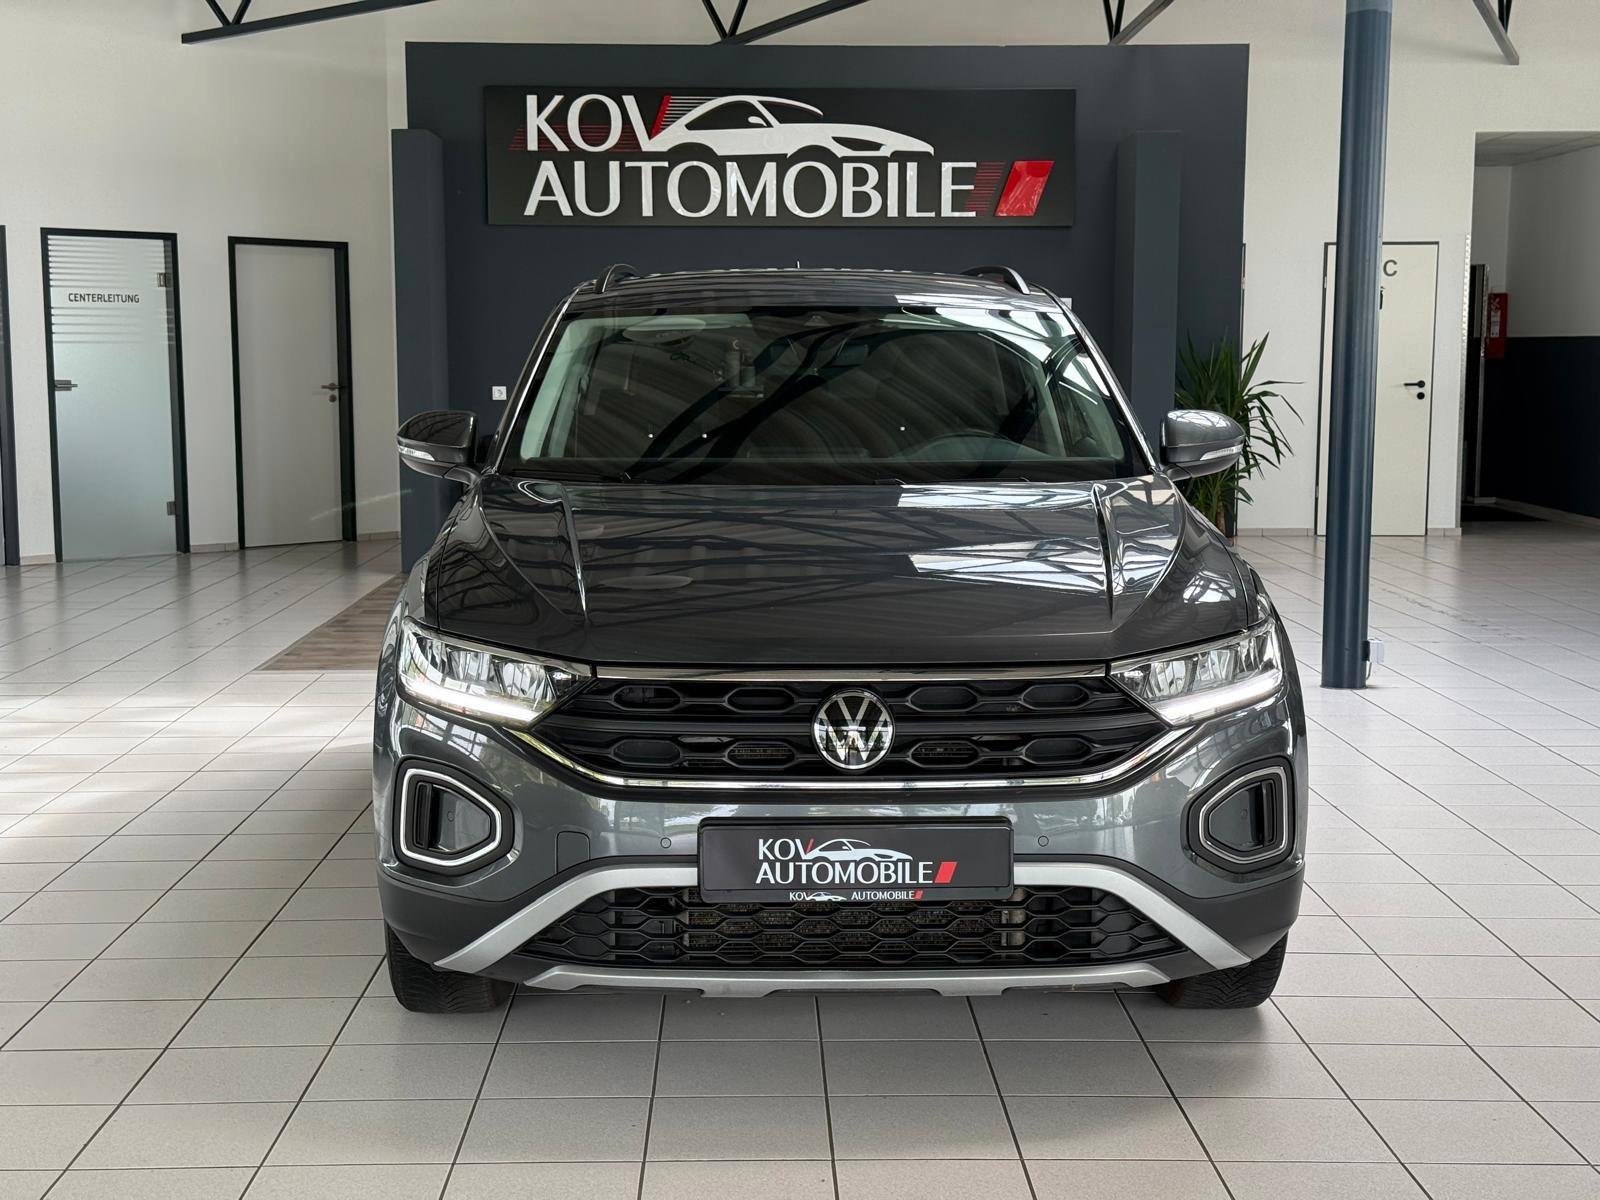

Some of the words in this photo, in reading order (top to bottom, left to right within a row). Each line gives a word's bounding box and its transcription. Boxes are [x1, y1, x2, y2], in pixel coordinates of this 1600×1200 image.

[523, 160, 978, 218] AUTOMOBILE
[68, 293, 140, 304] CENTERLEITUNG
[755, 861, 934, 884] AUTOMOBILE
[851, 890, 916, 901] AUTOMOBILE
